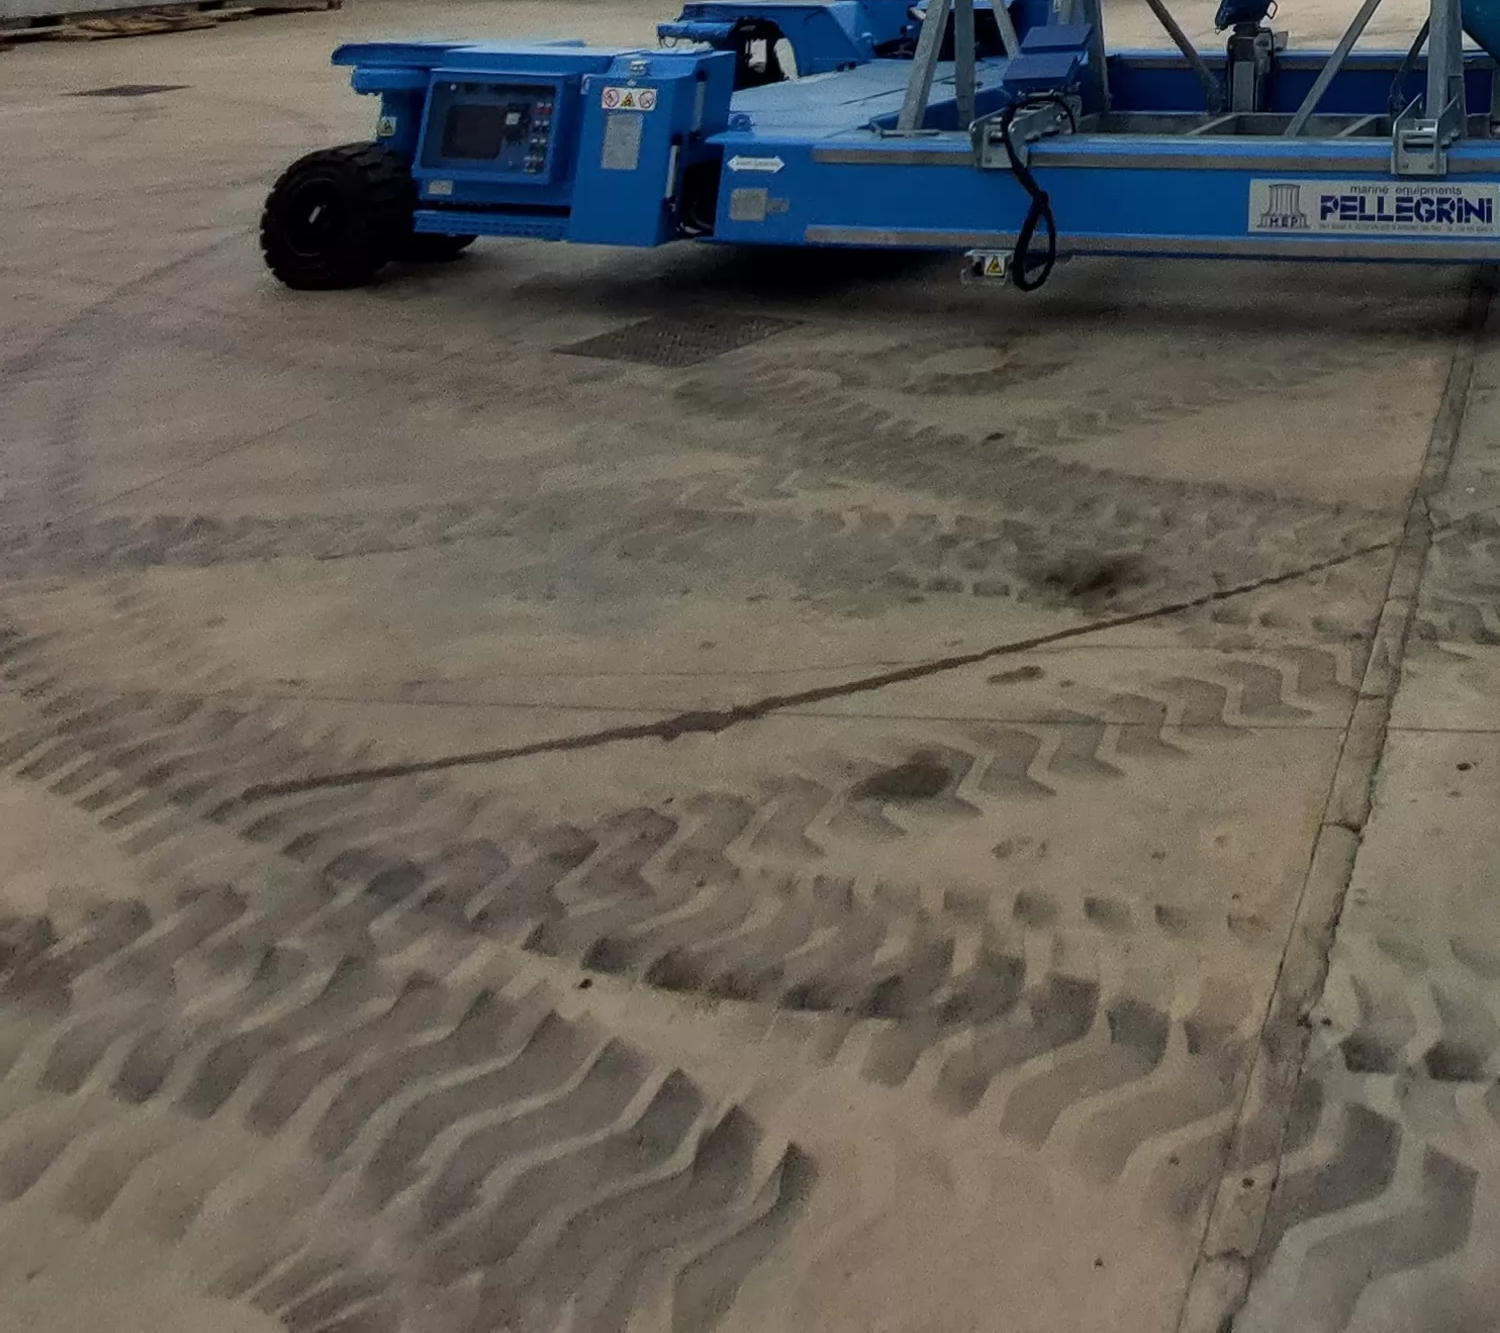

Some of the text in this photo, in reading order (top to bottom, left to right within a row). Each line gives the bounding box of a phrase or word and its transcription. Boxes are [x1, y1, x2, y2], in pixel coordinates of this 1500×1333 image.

[1350, 185, 1462, 196] marine equipments
[1320, 195, 1493, 224] PELLEGRINI
